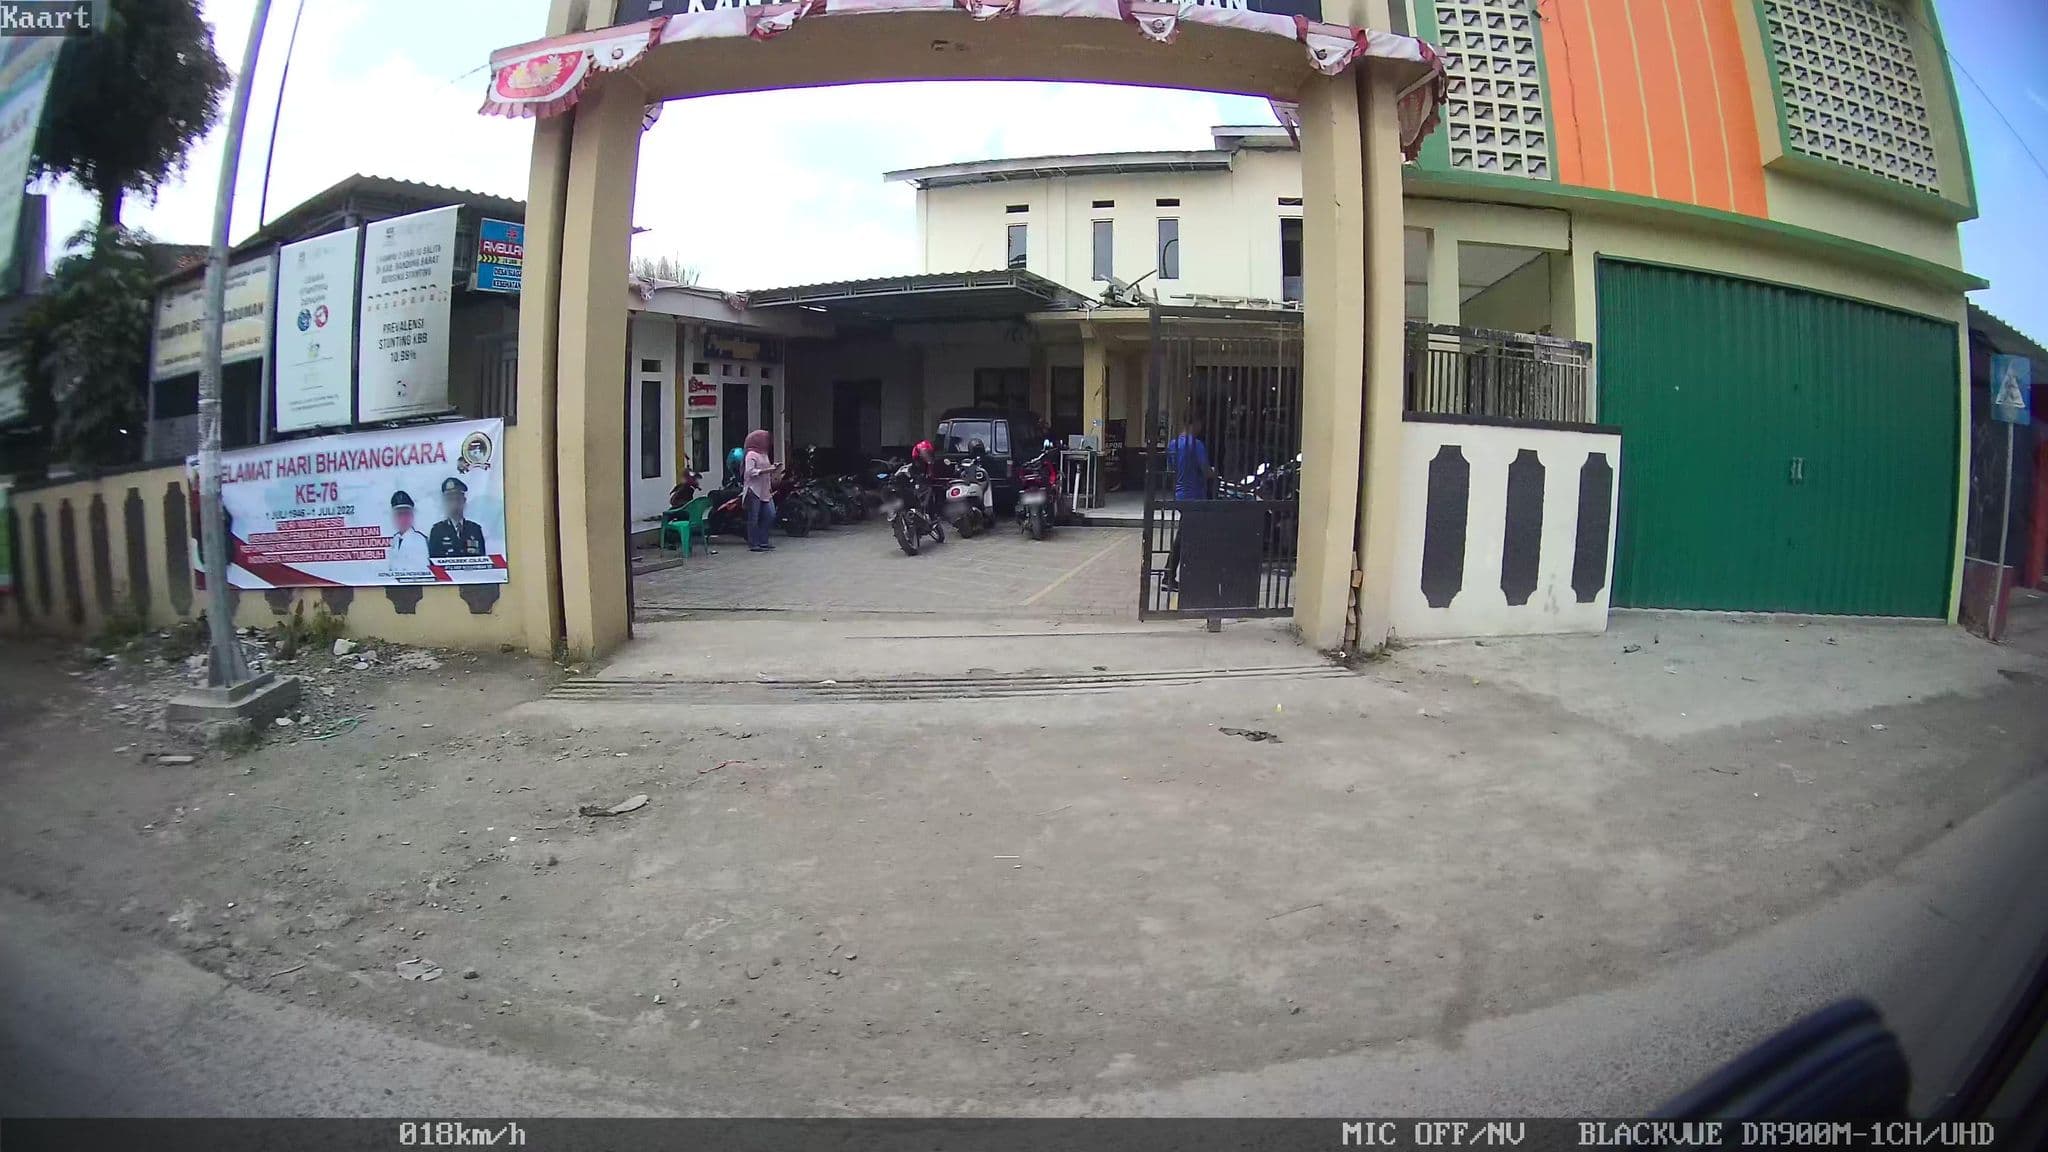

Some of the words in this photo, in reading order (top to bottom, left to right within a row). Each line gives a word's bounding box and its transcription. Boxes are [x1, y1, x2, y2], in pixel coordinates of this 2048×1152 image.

[382, 318, 425, 334] PREVALENSI
[378, 334, 412, 350] STUNTING
[412, 332, 428, 345] KBB
[220, 459, 273, 485] ELAMAT
[276, 454, 312, 478] HARI
[315, 441, 448, 475] BHAYANGKARA
[295, 480, 339, 505] KE-76
[317, 506, 336, 517] JULI
[336, 504, 355, 516] 2022
[363, 526, 380, 537] DAN
[351, 549, 384, 560] TUMBUH
